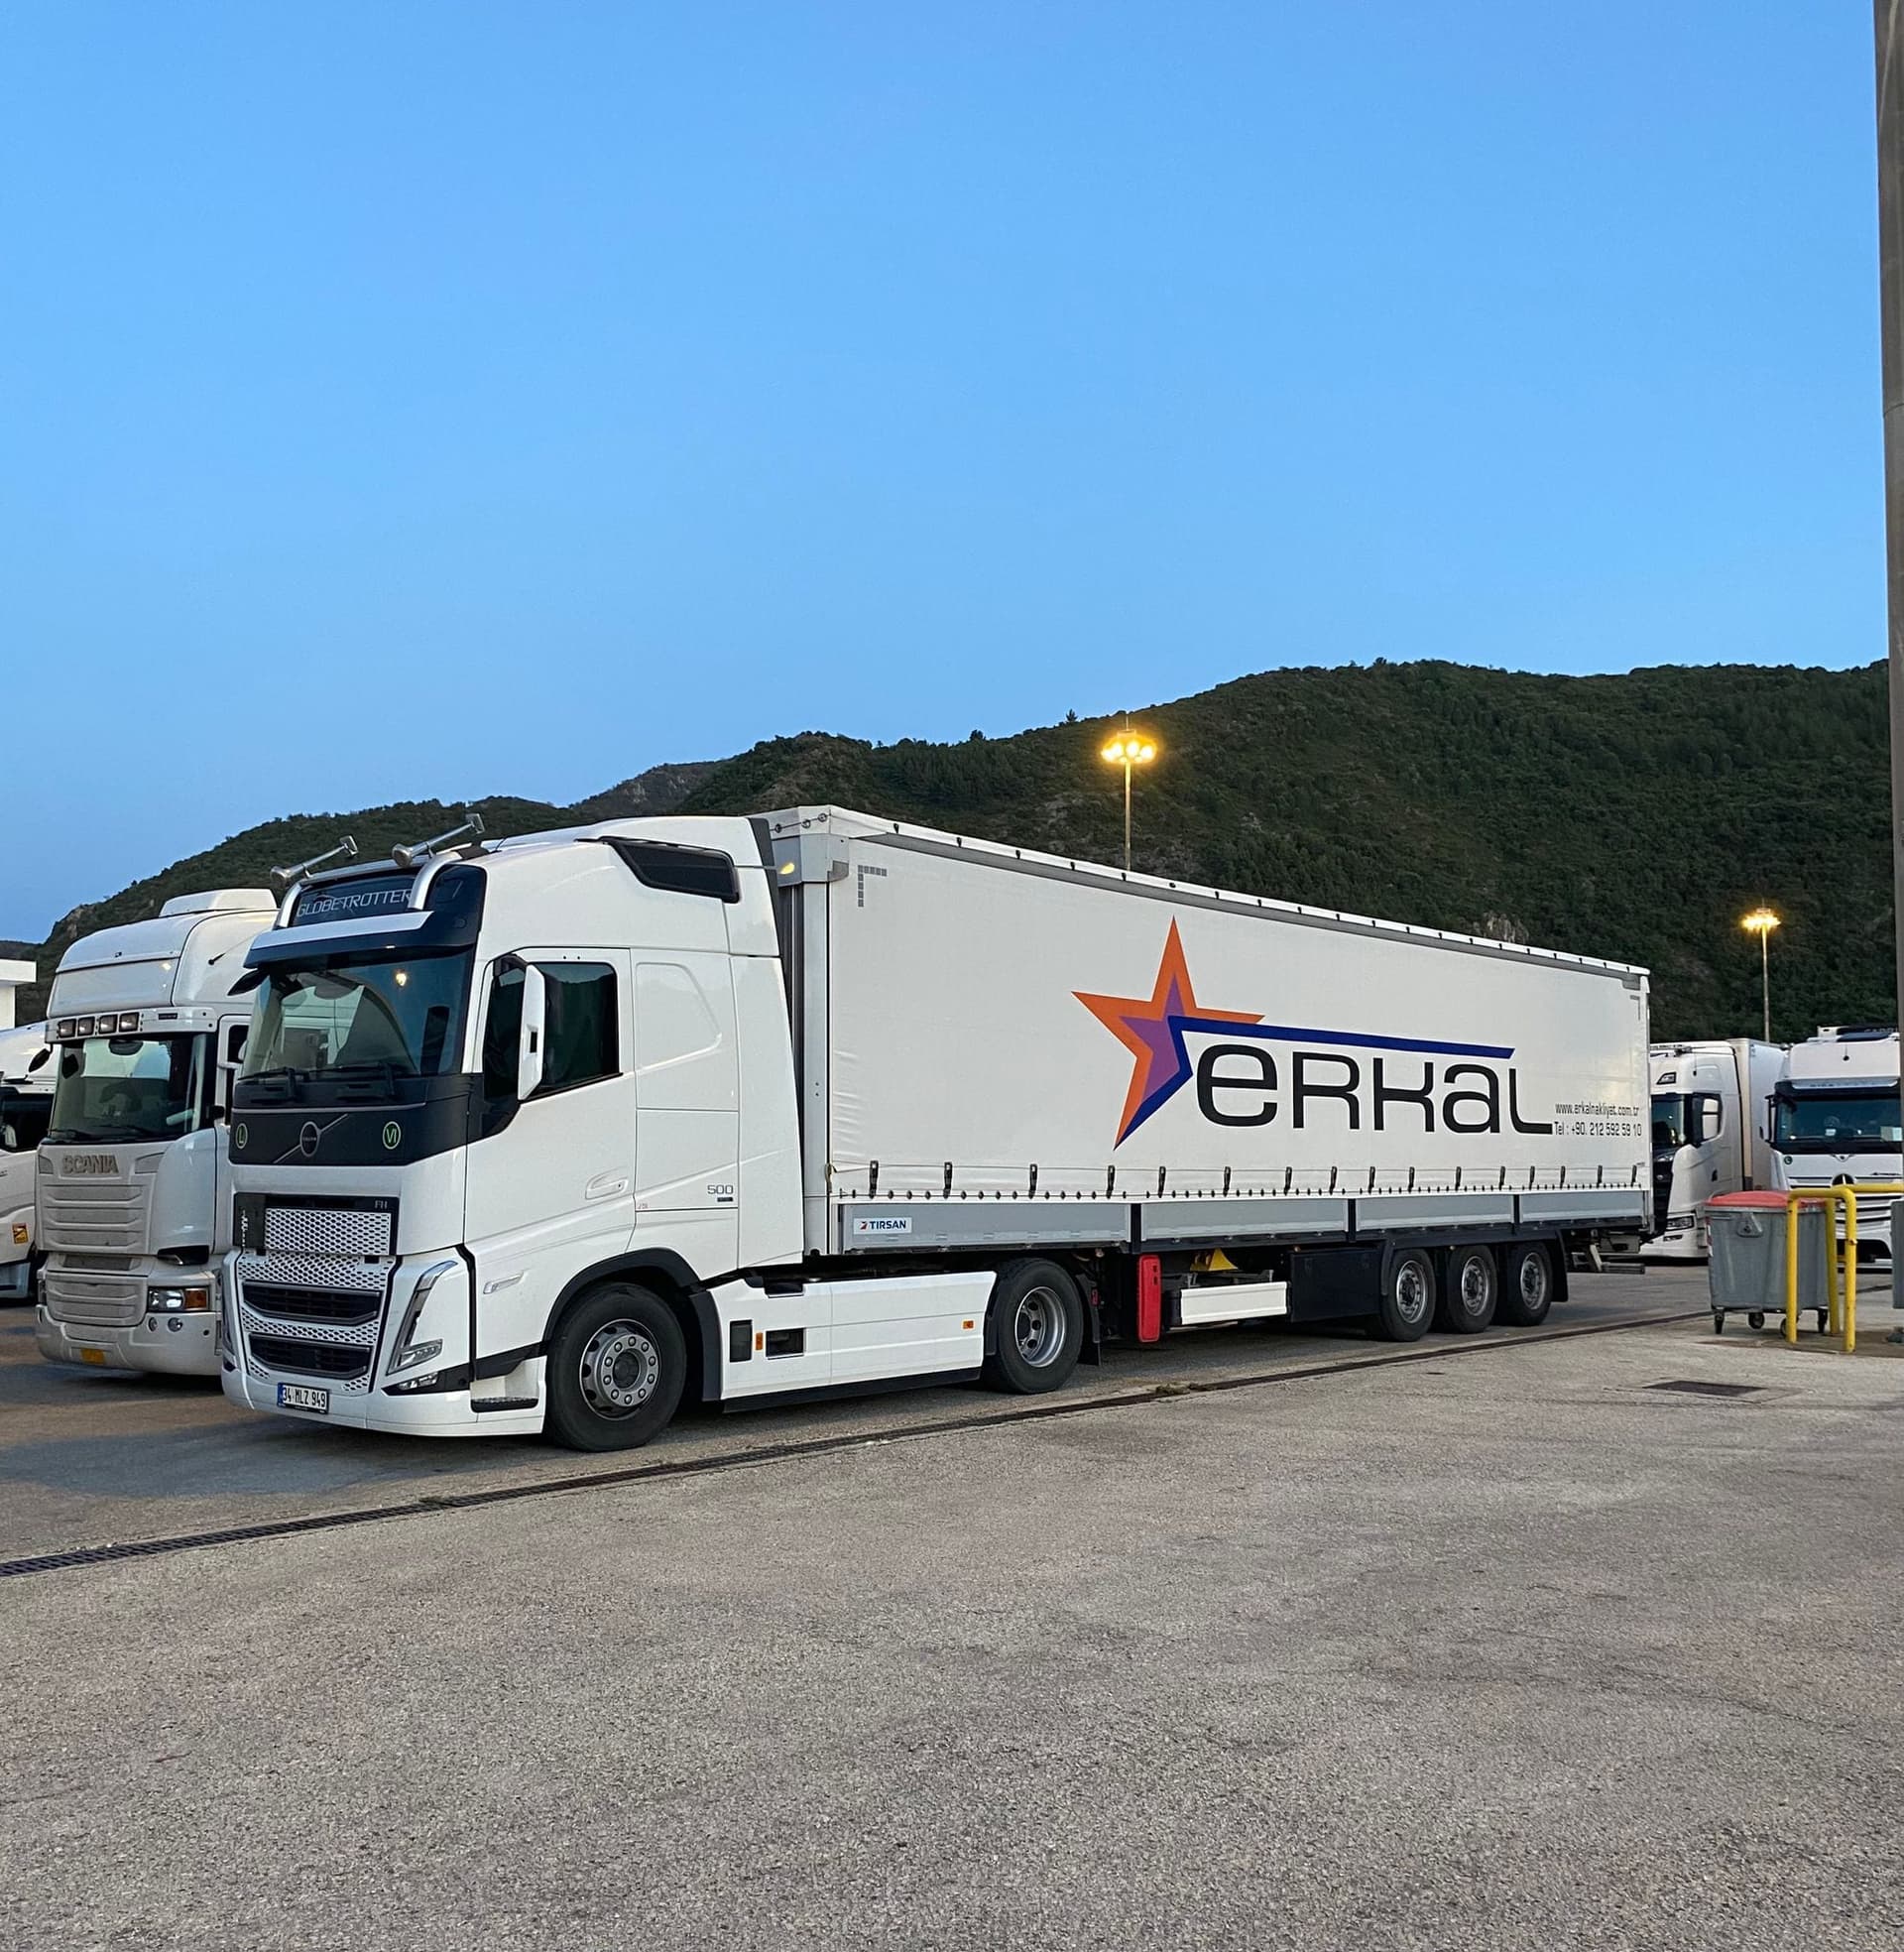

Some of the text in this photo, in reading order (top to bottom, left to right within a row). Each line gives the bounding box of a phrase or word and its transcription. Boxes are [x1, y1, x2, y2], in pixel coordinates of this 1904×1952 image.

[1554, 1122, 1565, 1136] Tel
[1590, 1122, 1605, 1137] 212
[1606, 1123, 1620, 1137] 592
[1621, 1123, 1631, 1137] 59
[1633, 1123, 1642, 1137] 10
[62, 1155, 119, 1174] SCANIA
[707, 1184, 734, 1195] 500
[869, 1220, 906, 1230] TIRSAN
[283, 1387, 326, 1408] 34 MLZ 949
